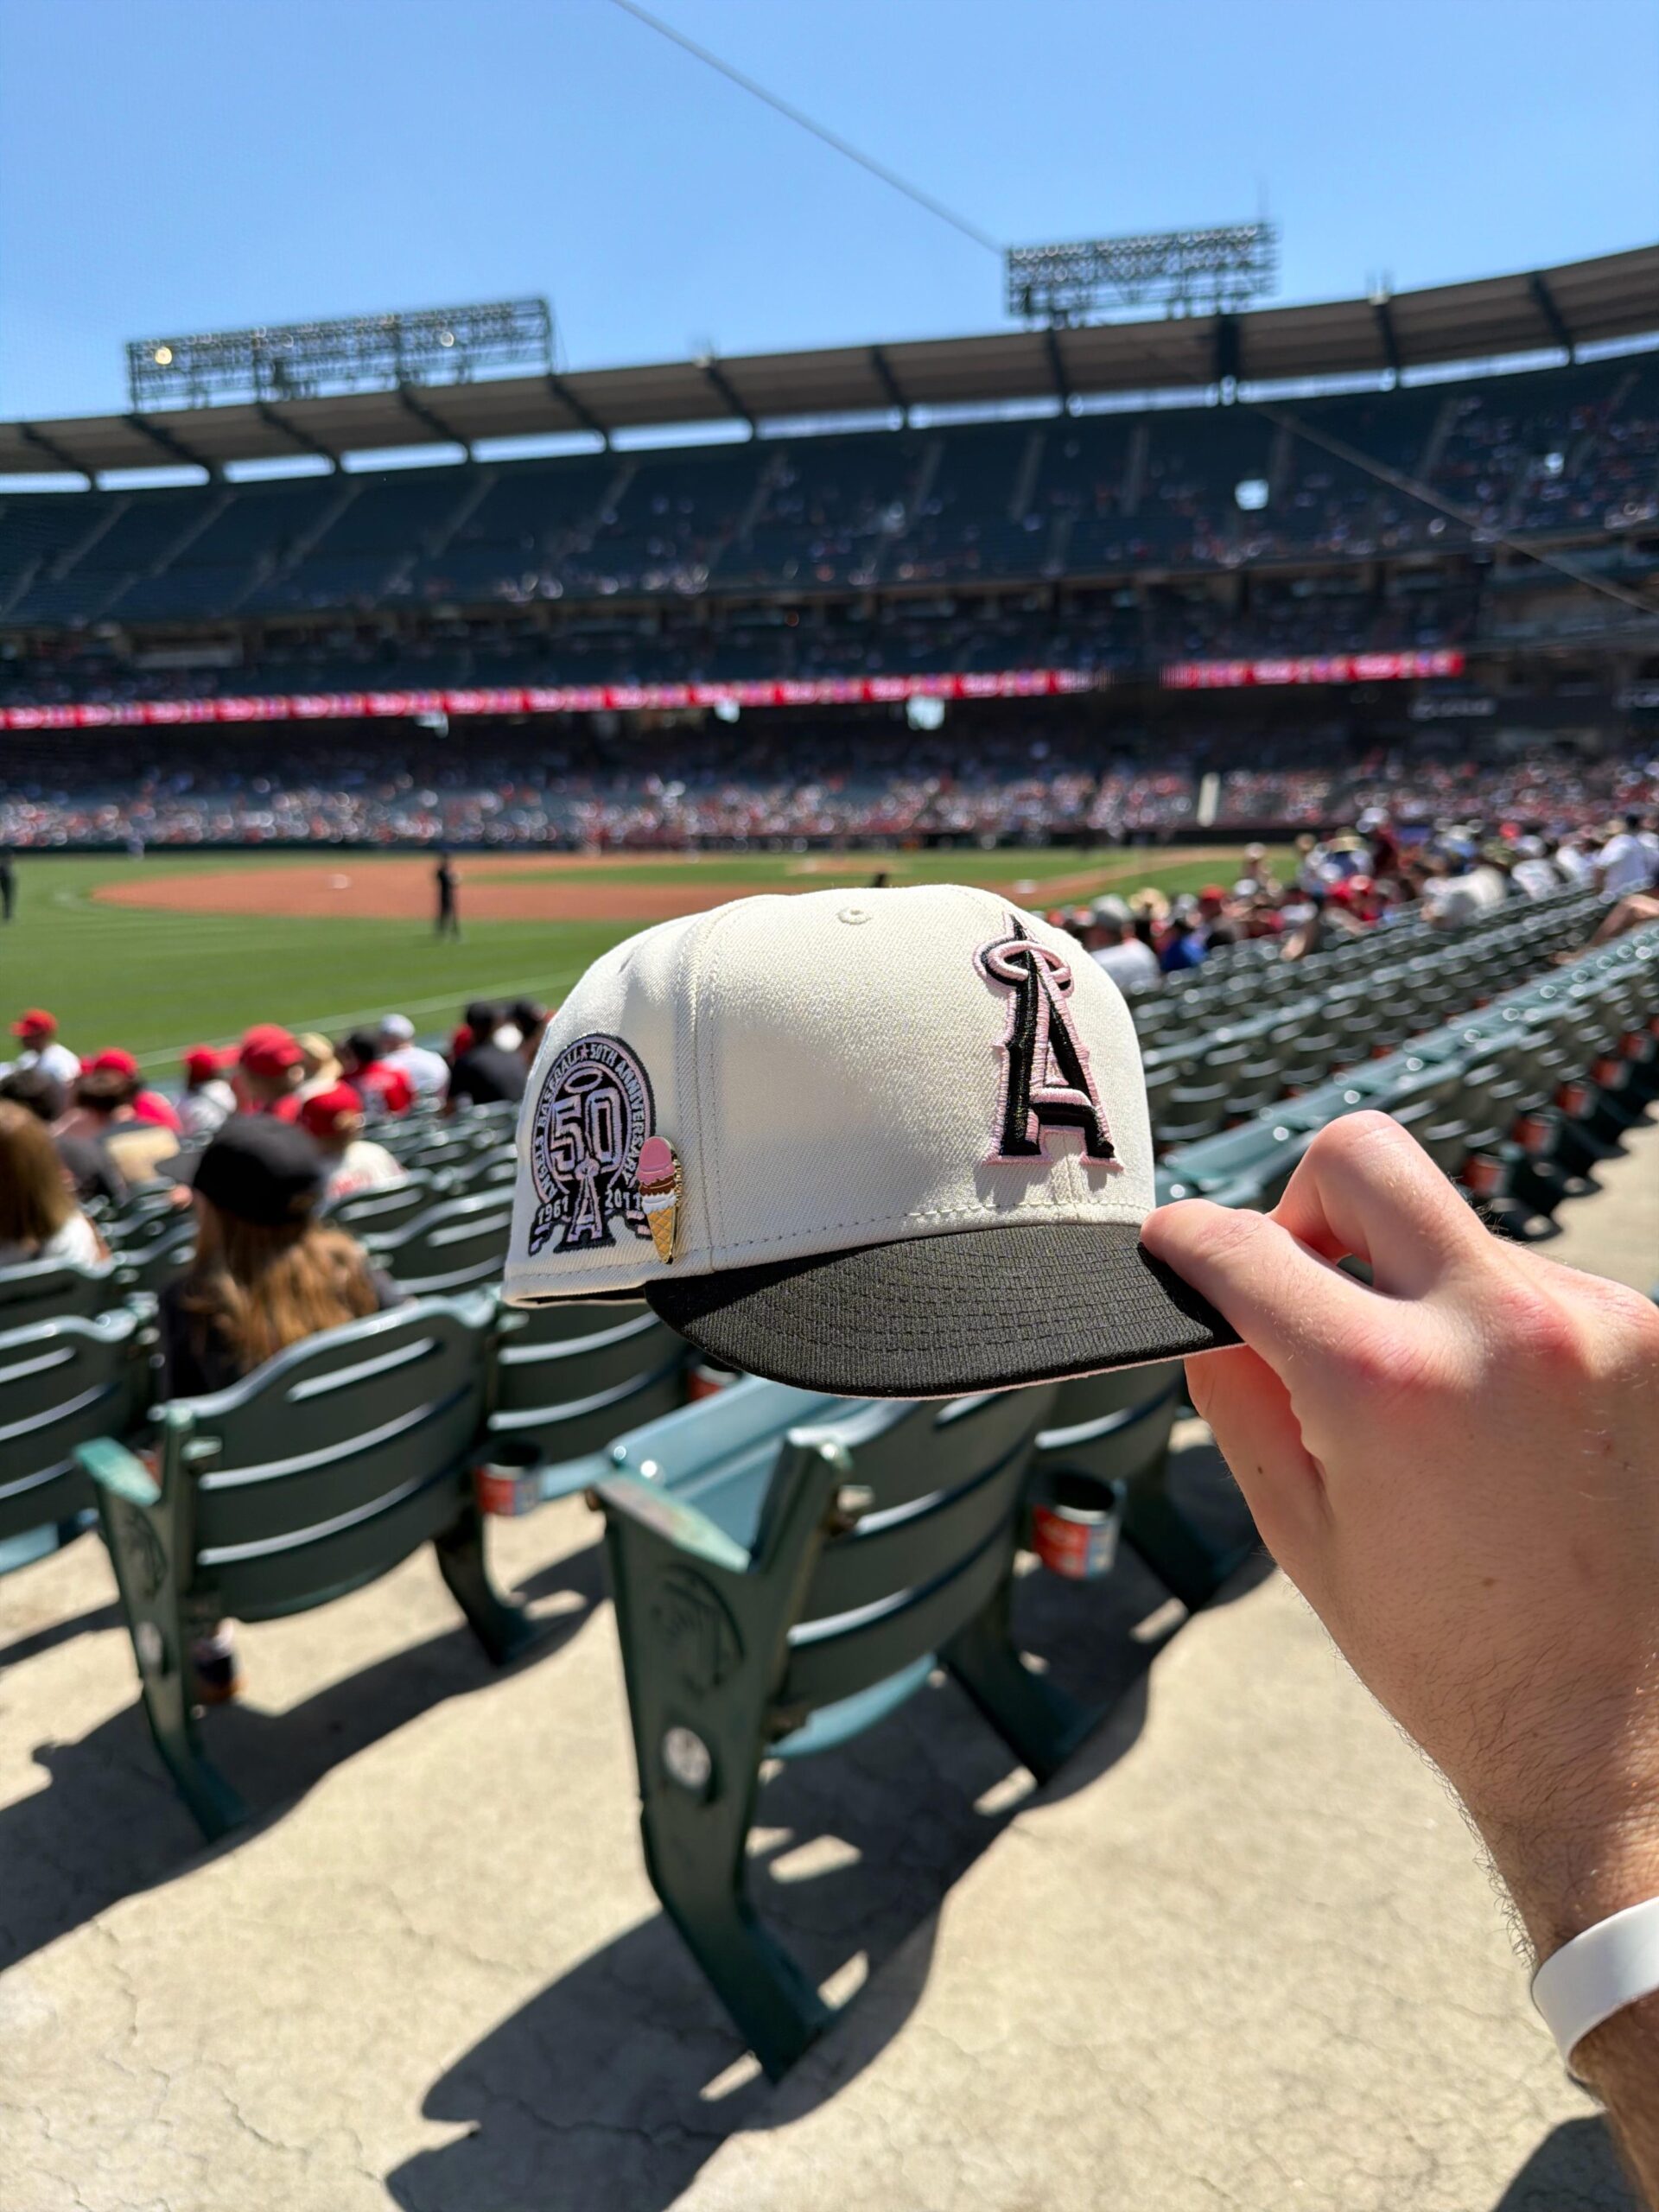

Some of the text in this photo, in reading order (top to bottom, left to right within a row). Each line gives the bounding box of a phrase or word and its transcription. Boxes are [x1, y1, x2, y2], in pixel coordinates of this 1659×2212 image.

[973, 911, 1123, 1170] A
[537, 1046, 582, 1128] BASEBALL
[590, 1043, 619, 1067] 50TH
[614, 1059, 645, 1185] ANNIVERSARY
[550, 1087, 622, 1181] 50
[537, 1190, 642, 1225] 1961 2011
